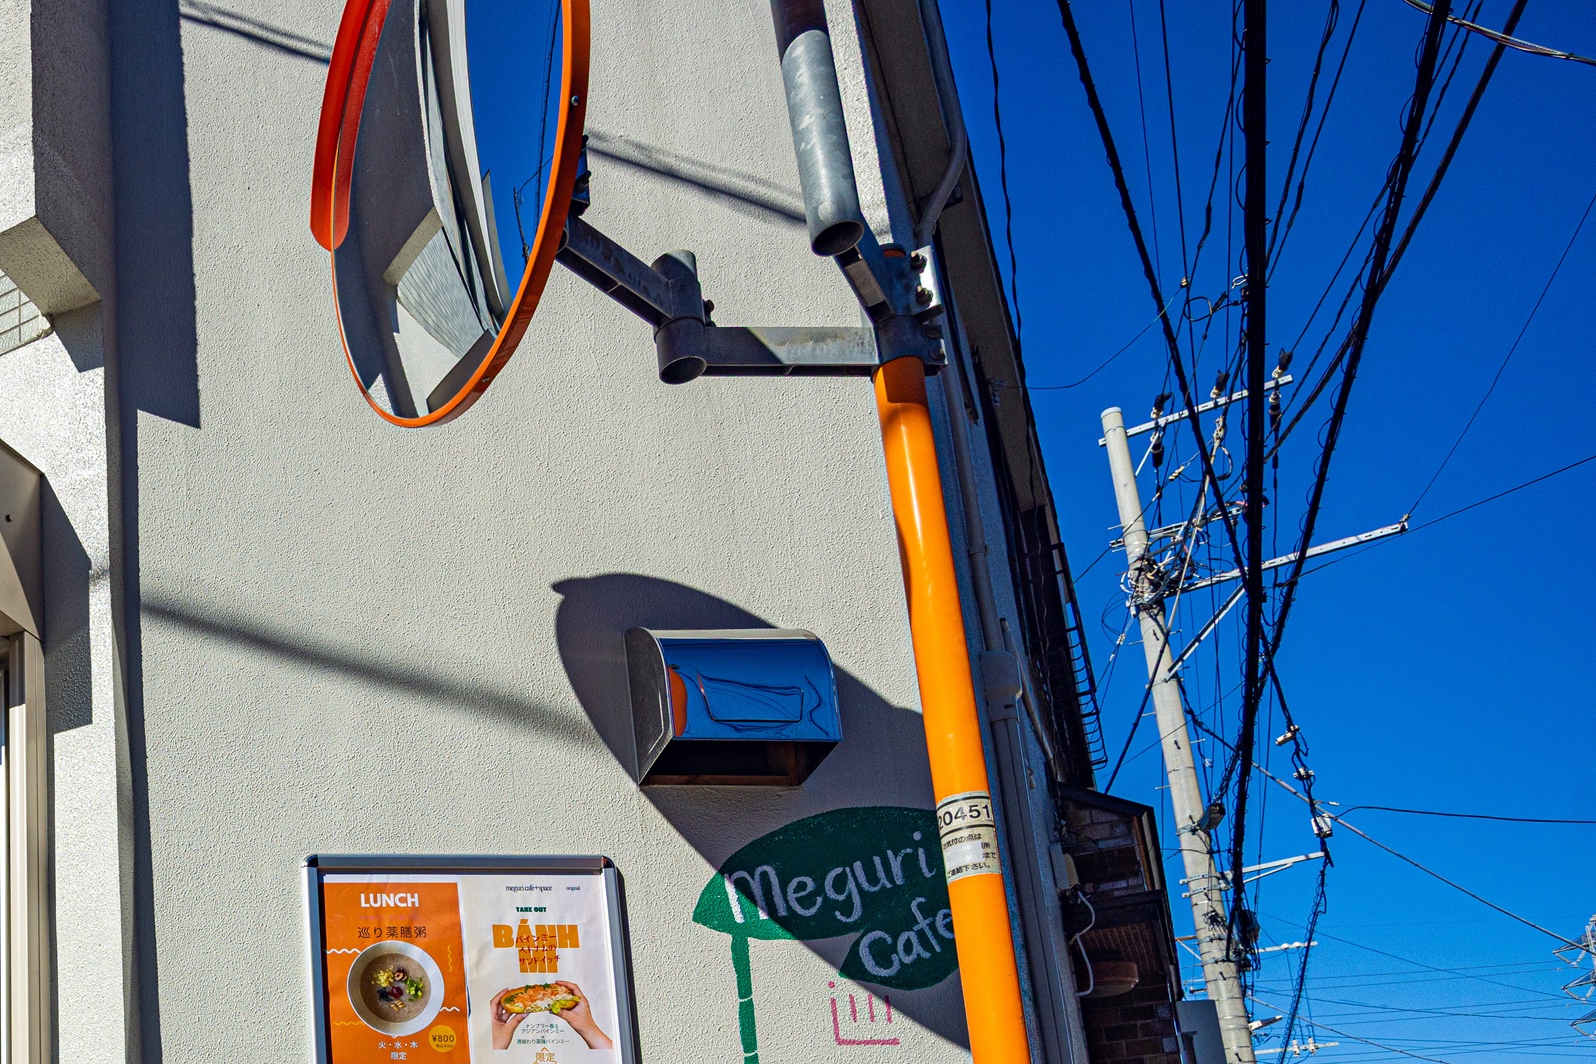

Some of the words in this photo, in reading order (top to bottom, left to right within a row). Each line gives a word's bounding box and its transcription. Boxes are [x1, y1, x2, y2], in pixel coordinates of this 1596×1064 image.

[724, 831, 936, 924] Meguri
[360, 893, 419, 907] LUNCH
[357, 926, 427, 938] 巡り薬膳粥
[492, 919, 580, 948] BÁNH
[859, 897, 955, 977] Cafe
[515, 933, 557, 944] バインミー
[519, 954, 561, 965] サンドイッチ
[432, 1034, 455, 1042] ¥800
[378, 1041, 418, 1049] 火・水・木
[391, 1052, 407, 1060] 限定
[535, 1052, 556, 1062] 限定
